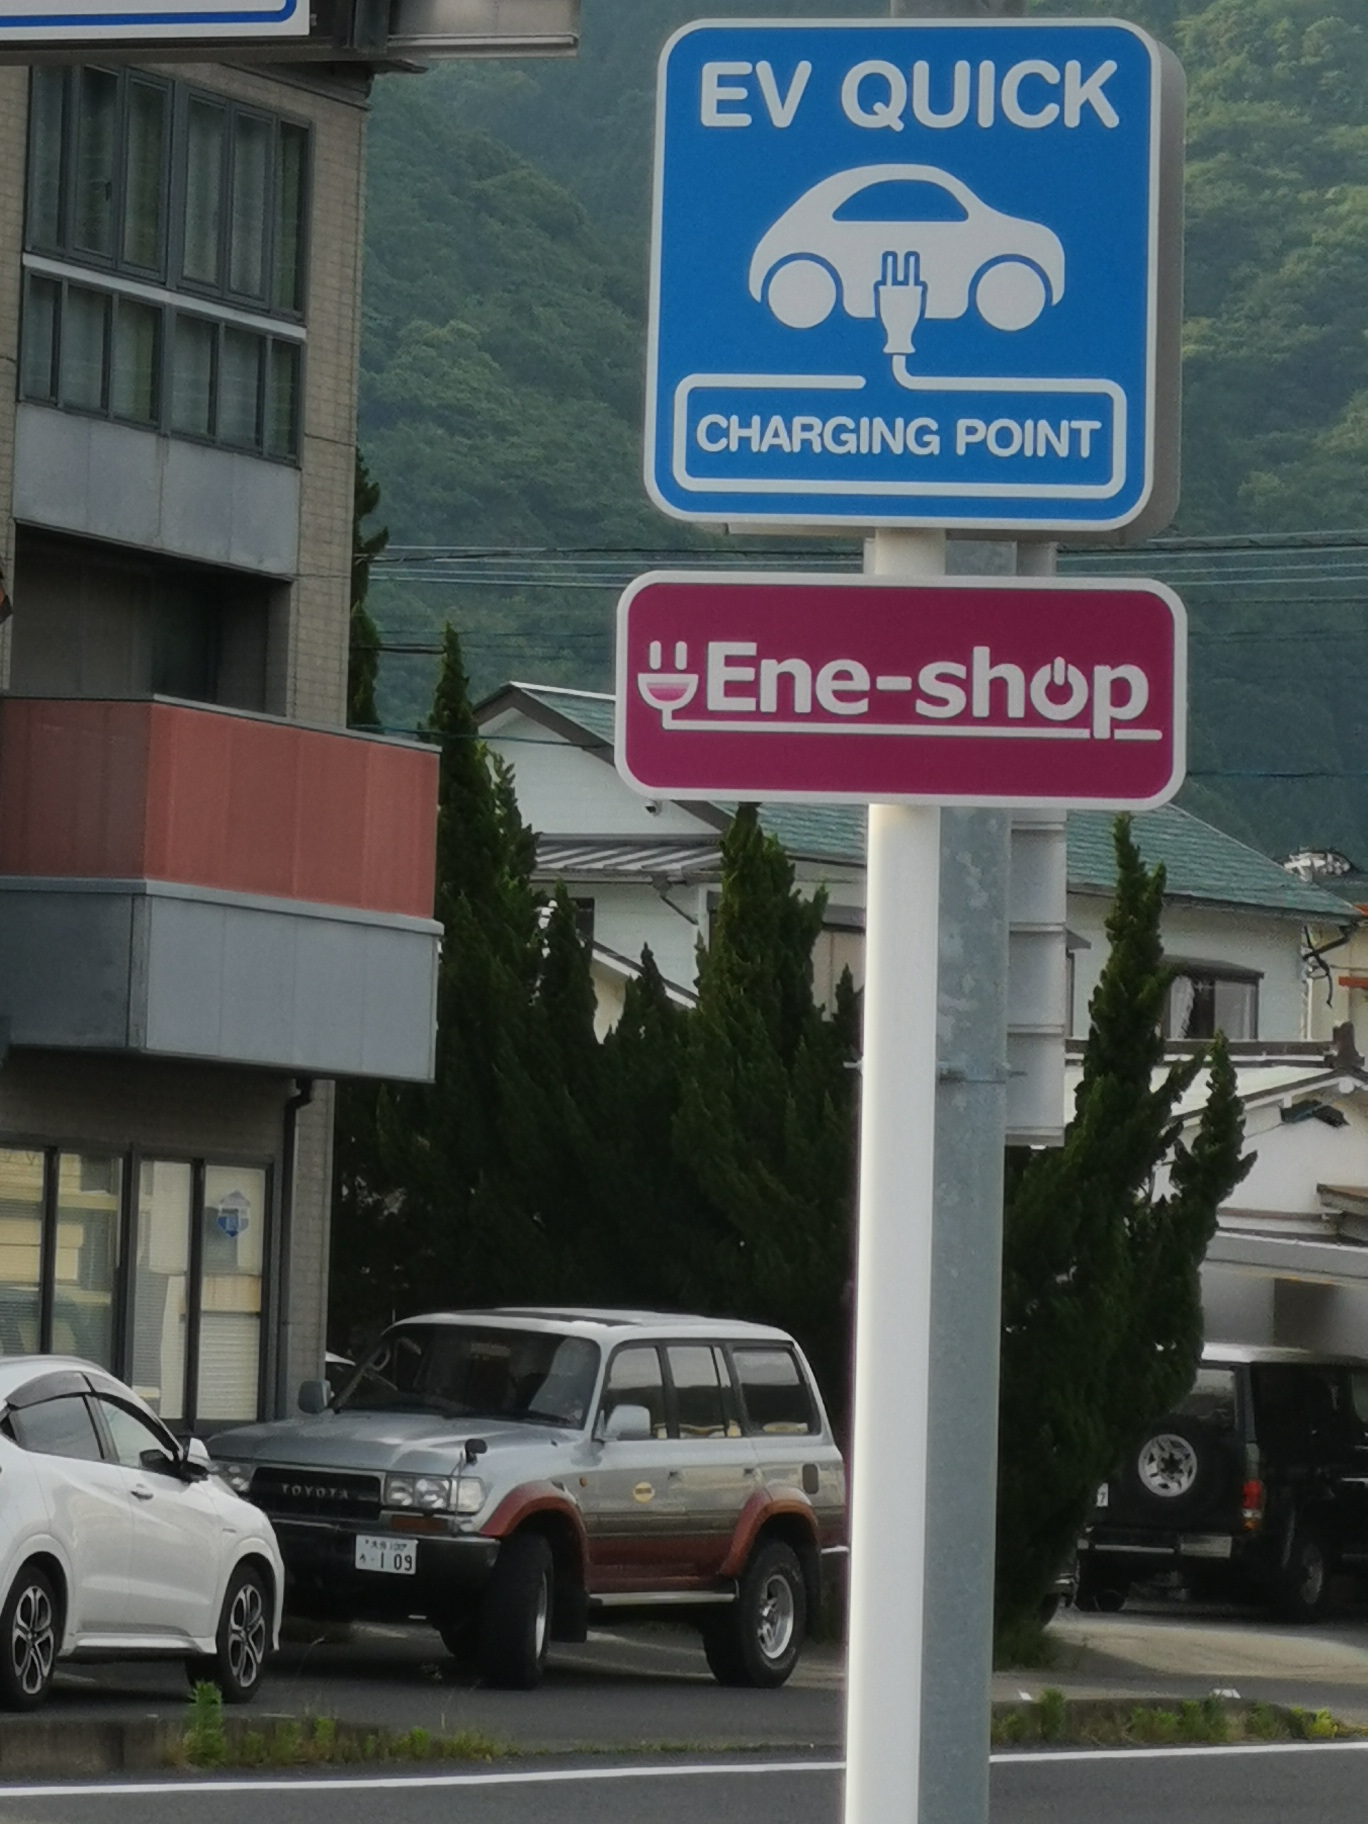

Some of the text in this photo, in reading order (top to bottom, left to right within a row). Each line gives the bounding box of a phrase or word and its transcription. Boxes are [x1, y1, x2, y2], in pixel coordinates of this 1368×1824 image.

[700, 59, 1120, 132] EV QUICK
[696, 413, 1103, 458] CHARGING POINT
[706, 640, 1150, 740] Ene-shop
[281, 1483, 349, 1500] TOYOTA
